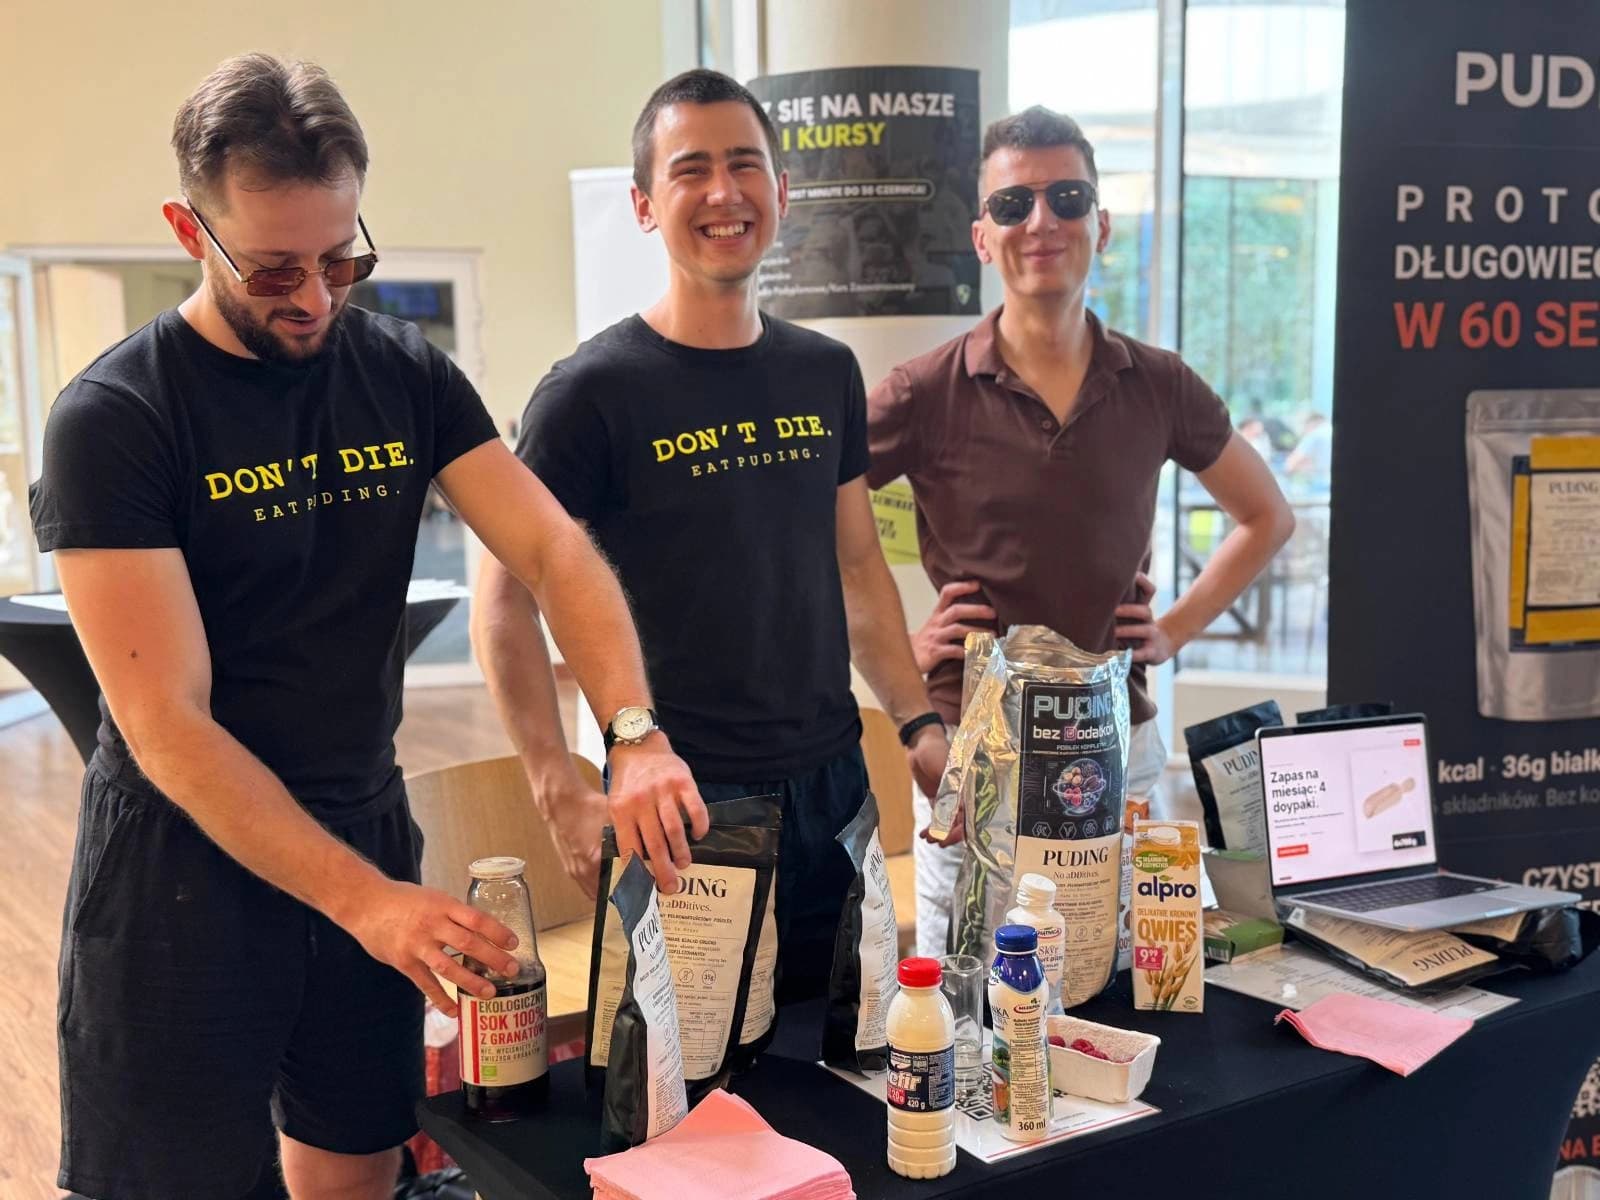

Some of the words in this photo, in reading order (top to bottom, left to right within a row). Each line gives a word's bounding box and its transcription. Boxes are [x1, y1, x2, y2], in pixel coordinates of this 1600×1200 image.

[1455, 51, 1600, 108] PUD
[778, 97, 815, 125] SIĘ
[821, 95, 862, 119] NA
[869, 93, 955, 117] NASZE
[797, 122, 886, 150] KURSY
[1394, 301, 1445, 349] W
[1460, 301, 1521, 349] 60
[1535, 301, 1600, 349] SE
[652, 422, 757, 462] DON'T
[774, 415, 833, 439] DIE.
[204, 453, 318, 500] DON'T
[338, 441, 414, 473] DIE.
[691, 459, 729, 477] EAT
[737, 447, 820, 468] PUDING.
[253, 501, 298, 521] EAT
[1033, 725, 1061, 740] bez
[1270, 771, 1304, 785] Zapas
[1305, 770, 1320, 779] na
[1438, 757, 1483, 783] kcal
[1501, 754, 1546, 782] 36g
[1272, 785, 1317, 799] miesiąc:
[1319, 781, 1327, 792] 4
[1545, 787, 1577, 806] Bez
[1273, 797, 1320, 814] doypaki.
[1042, 847, 1109, 867] PUDING
[1135, 856, 1143, 868] 5
[1137, 875, 1197, 902] alpro
[1412, 943, 1475, 972] PUDING
[480, 1015, 508, 1030] SOK
[513, 1006, 545, 1028] 100%
[480, 1033, 487, 1045] Z
[888, 1070, 922, 1092] efir
[907, 1100, 920, 1108] 420
[1018, 1121, 1035, 1131] 360
[1036, 1118, 1046, 1129] ml
